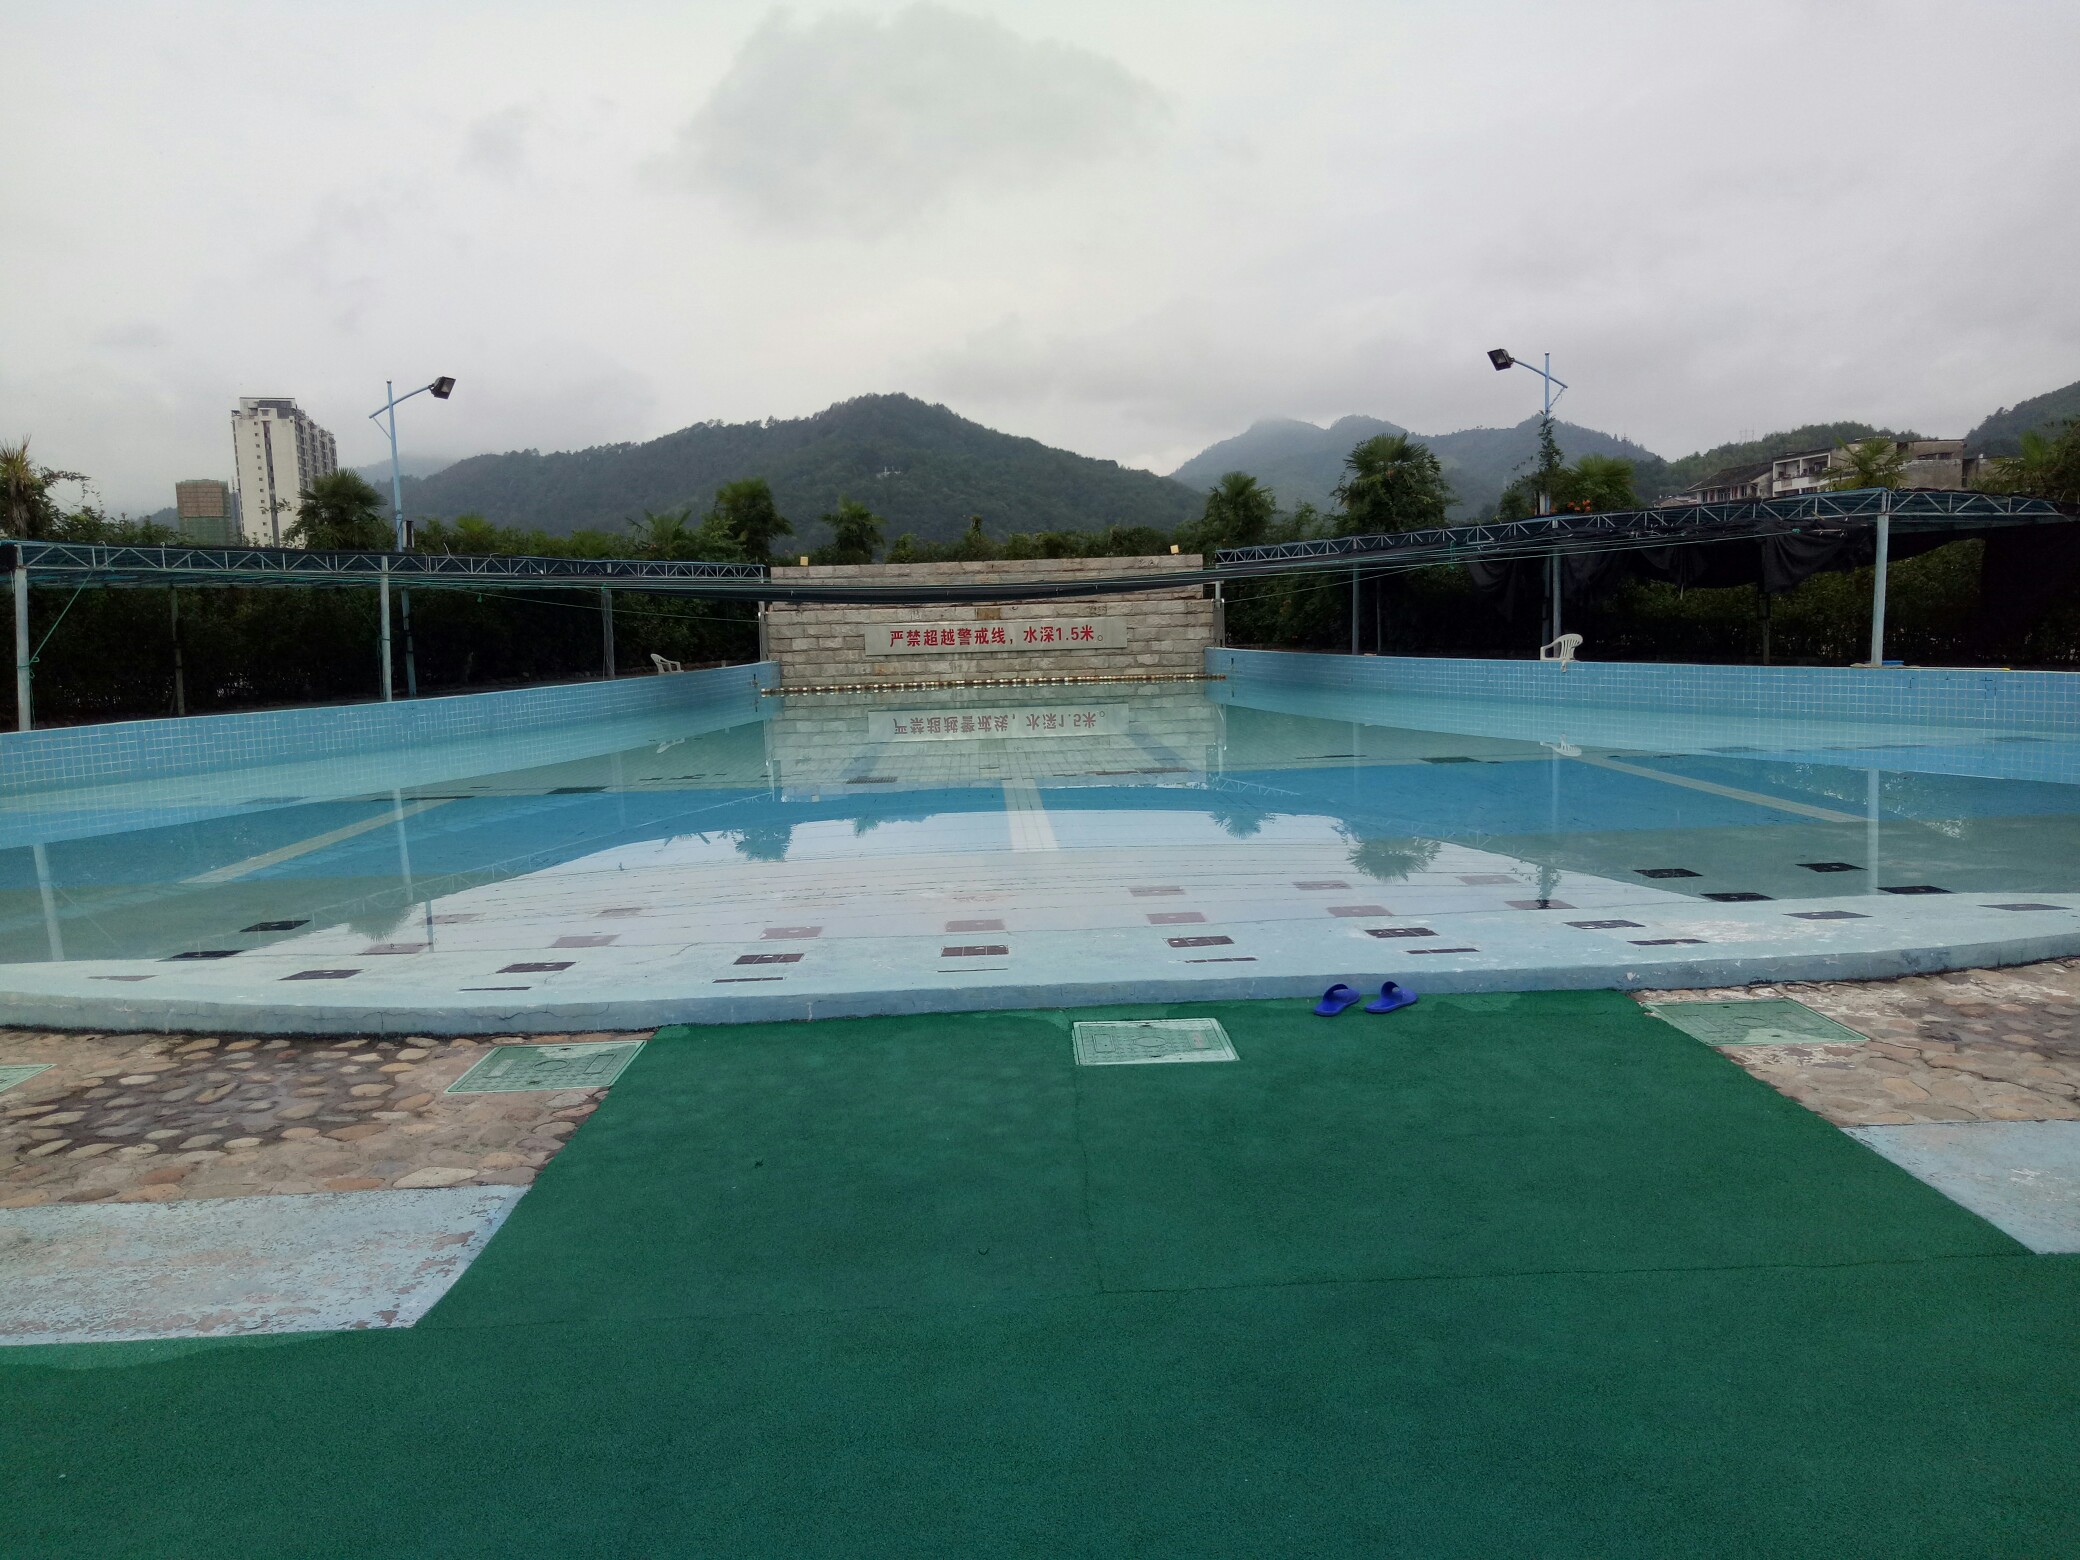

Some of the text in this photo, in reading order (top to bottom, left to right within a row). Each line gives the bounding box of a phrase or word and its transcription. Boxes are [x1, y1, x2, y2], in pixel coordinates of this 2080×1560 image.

[889, 625, 1104, 647] 严禁超越警戒线，水深1.5米。
